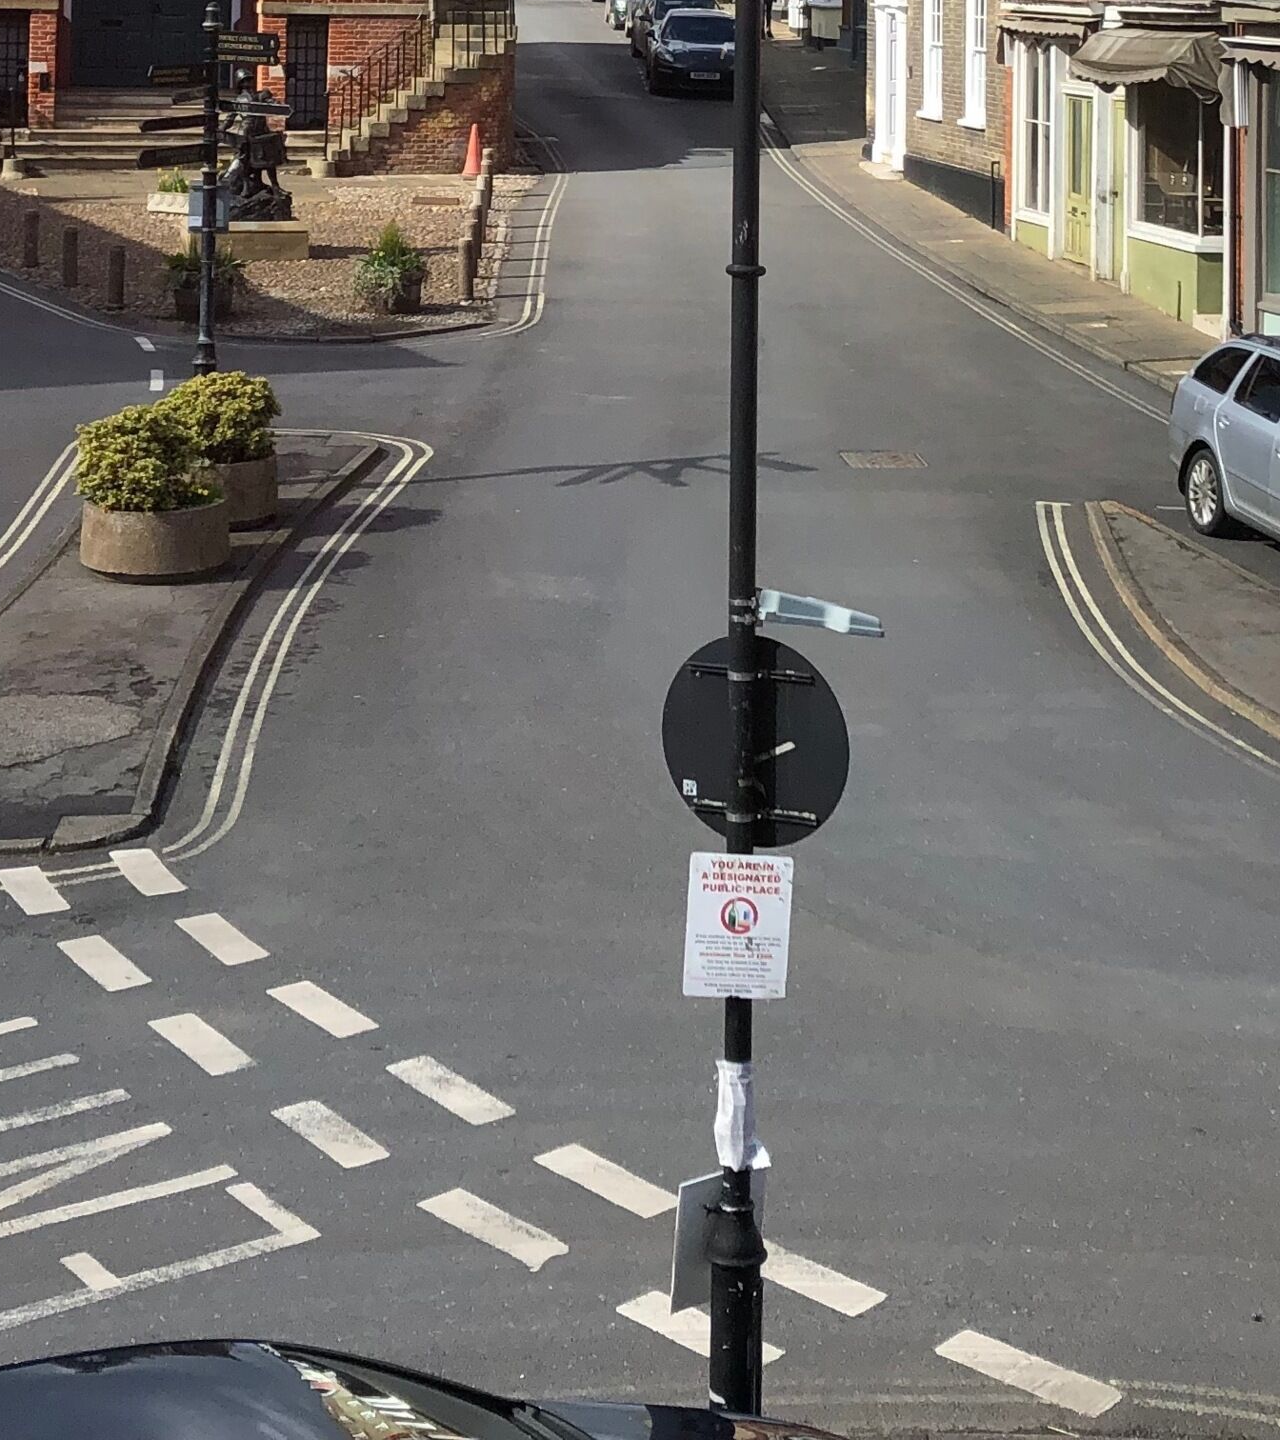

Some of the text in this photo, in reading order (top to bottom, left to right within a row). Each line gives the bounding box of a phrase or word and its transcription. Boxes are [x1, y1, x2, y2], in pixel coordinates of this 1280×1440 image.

[711, 860, 774, 872] YOU ARE IN
[701, 871, 782, 884] A DESIGNATED
[702, 883, 780, 895] PUBLIC PLACE
